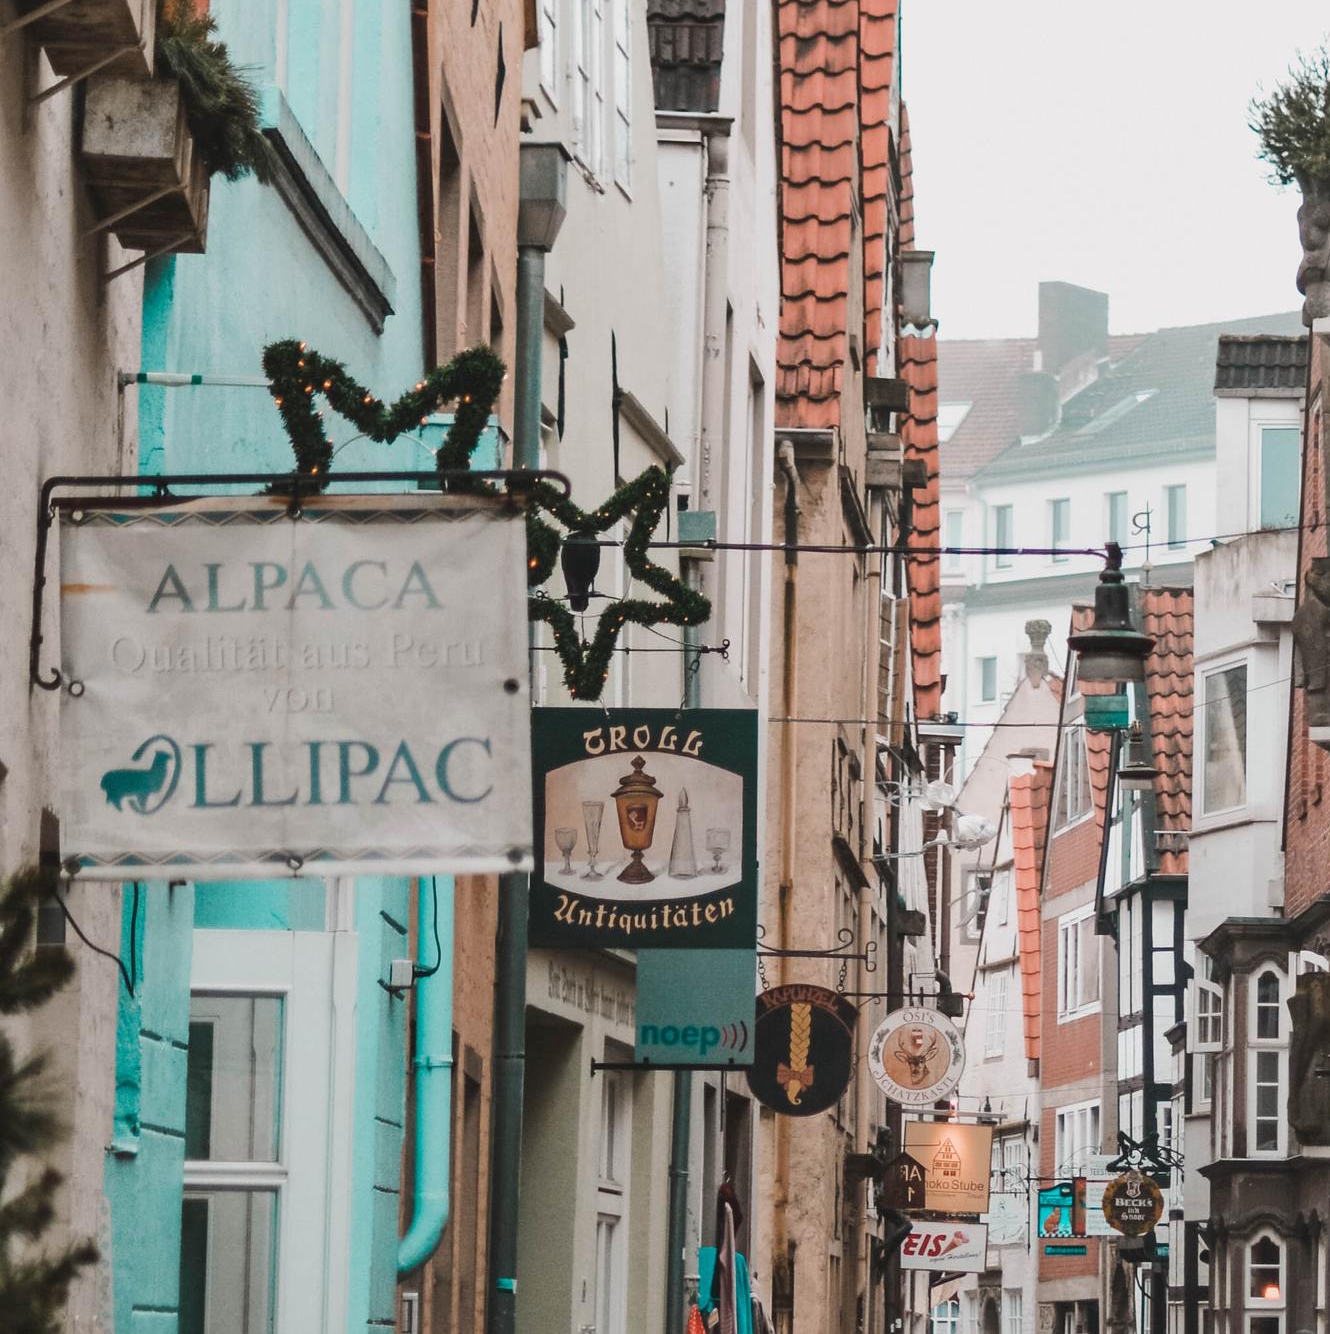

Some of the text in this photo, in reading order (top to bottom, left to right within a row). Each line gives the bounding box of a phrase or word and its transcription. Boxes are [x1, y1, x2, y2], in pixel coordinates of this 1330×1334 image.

[145, 559, 444, 614] ALPACA
[111, 632, 485, 673] Qualität aus Peru
[263, 687, 336, 714] von
[583, 725, 704, 756] TROLL
[553, 894, 735, 935] Antiquitäten
[761, 986, 839, 1011] RAPUNZEL
[641, 1025, 720, 1056] noep
[926, 1179, 984, 1192] oko Stube
[903, 1233, 947, 1257] EIS
